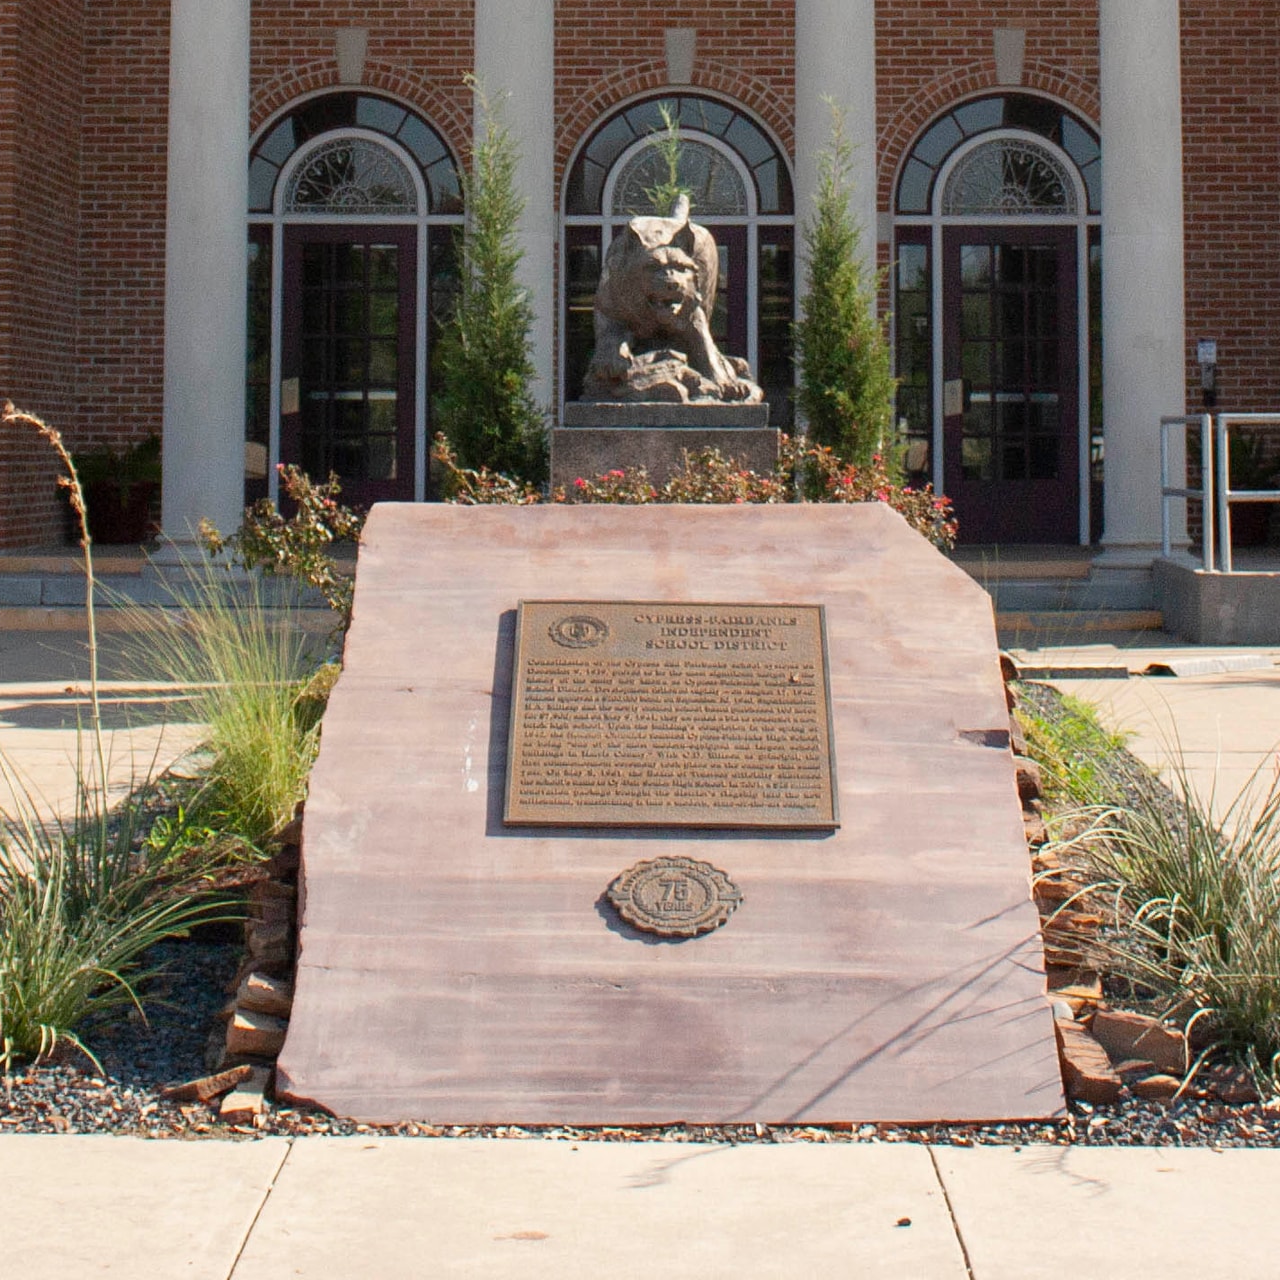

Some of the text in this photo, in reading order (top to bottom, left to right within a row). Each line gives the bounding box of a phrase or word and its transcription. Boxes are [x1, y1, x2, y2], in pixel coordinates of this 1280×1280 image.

[660, 627, 772, 638] INDEPENDENT
[645, 639, 789, 652] SCHOOL DISTRICT
[659, 882, 688, 901] 75
